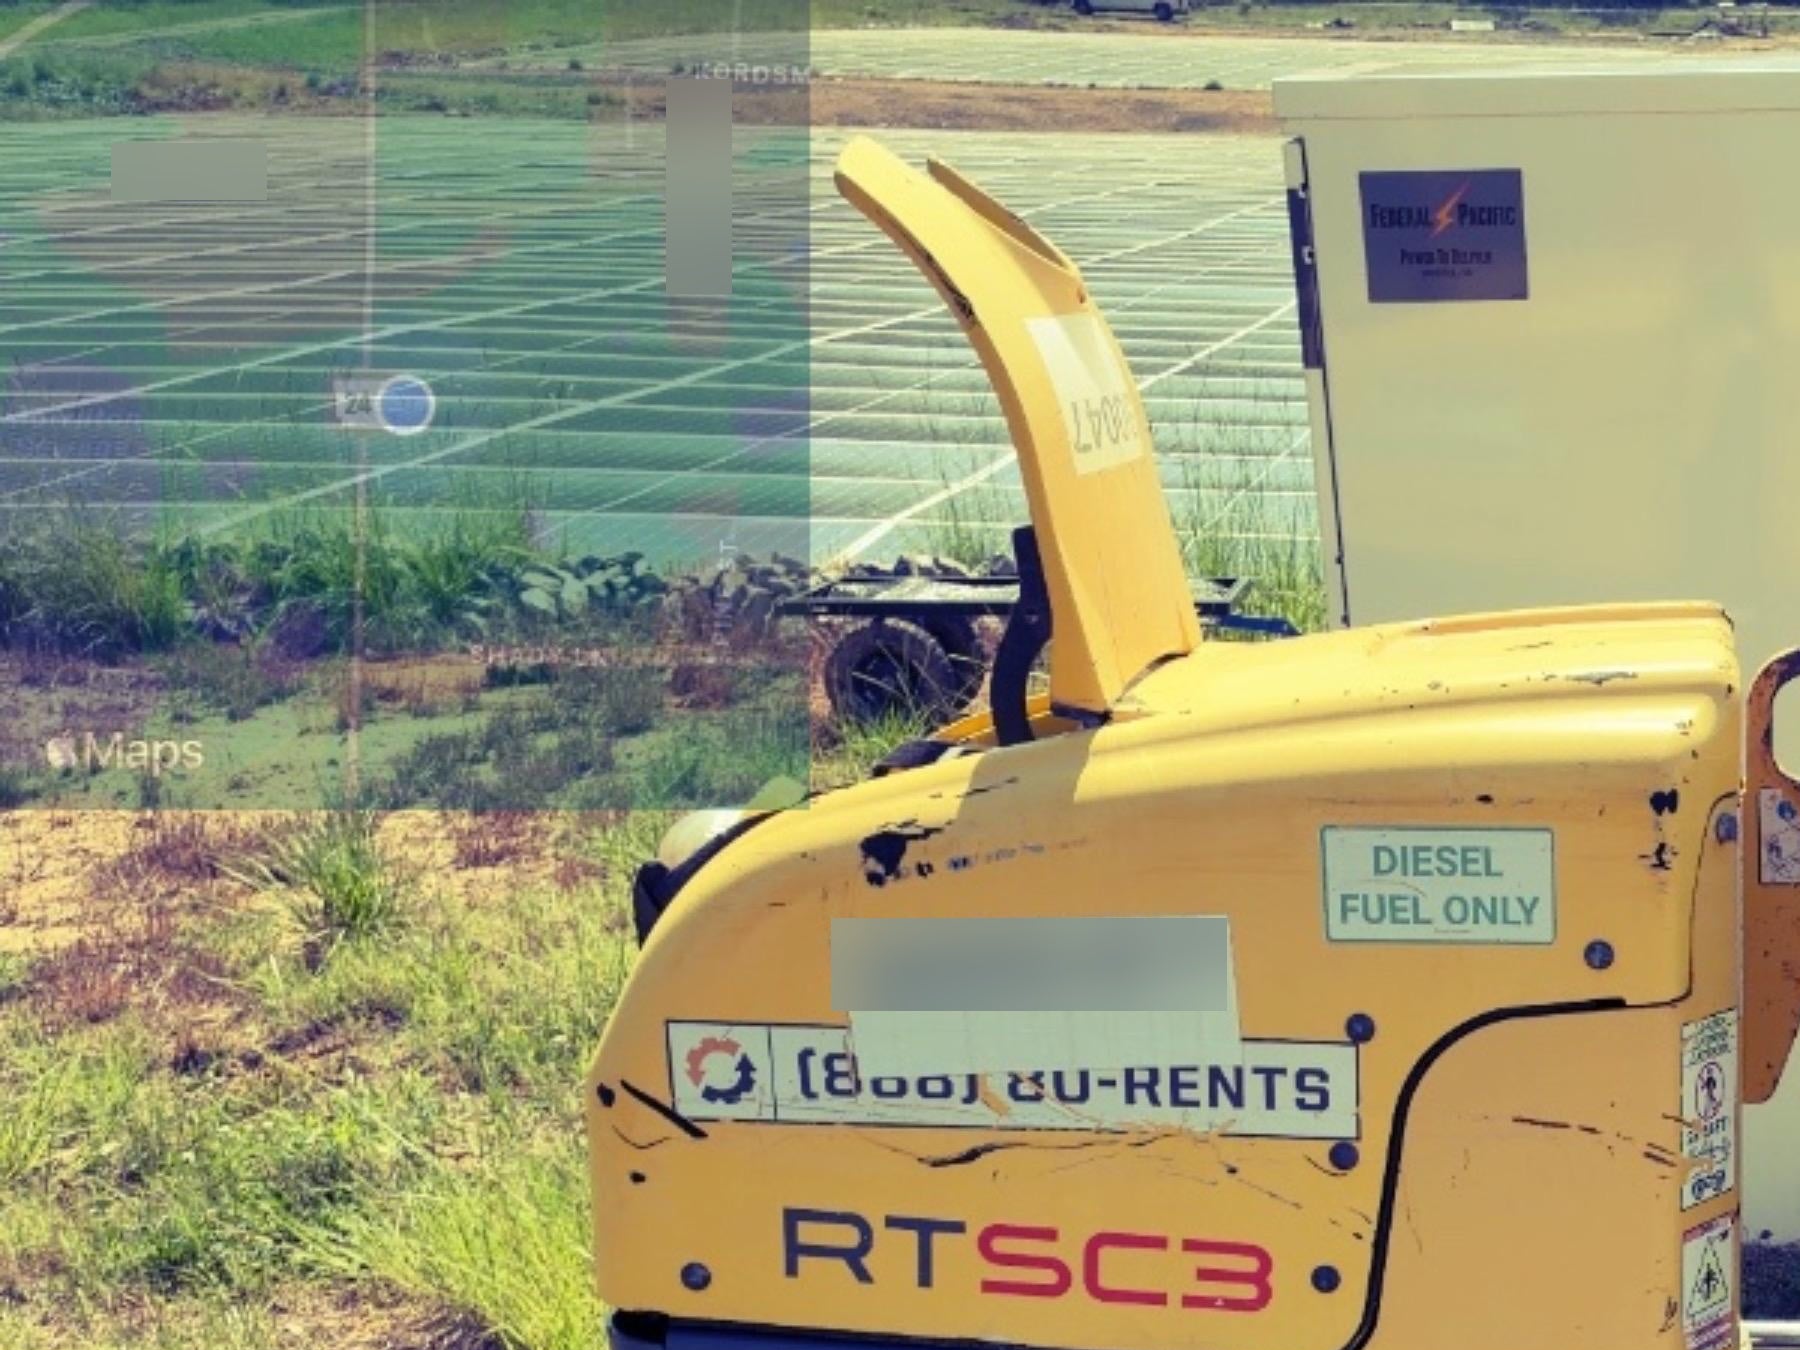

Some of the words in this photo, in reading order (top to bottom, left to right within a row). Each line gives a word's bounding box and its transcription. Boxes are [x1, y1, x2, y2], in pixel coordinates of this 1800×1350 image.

[1369, 203, 1434, 229] FEDERAL
[1457, 203, 1516, 228] PACIFIC
[1372, 845, 1504, 877] DIESEL
[1339, 893, 1433, 925] FUEL
[1442, 896, 1541, 926] ONLY
